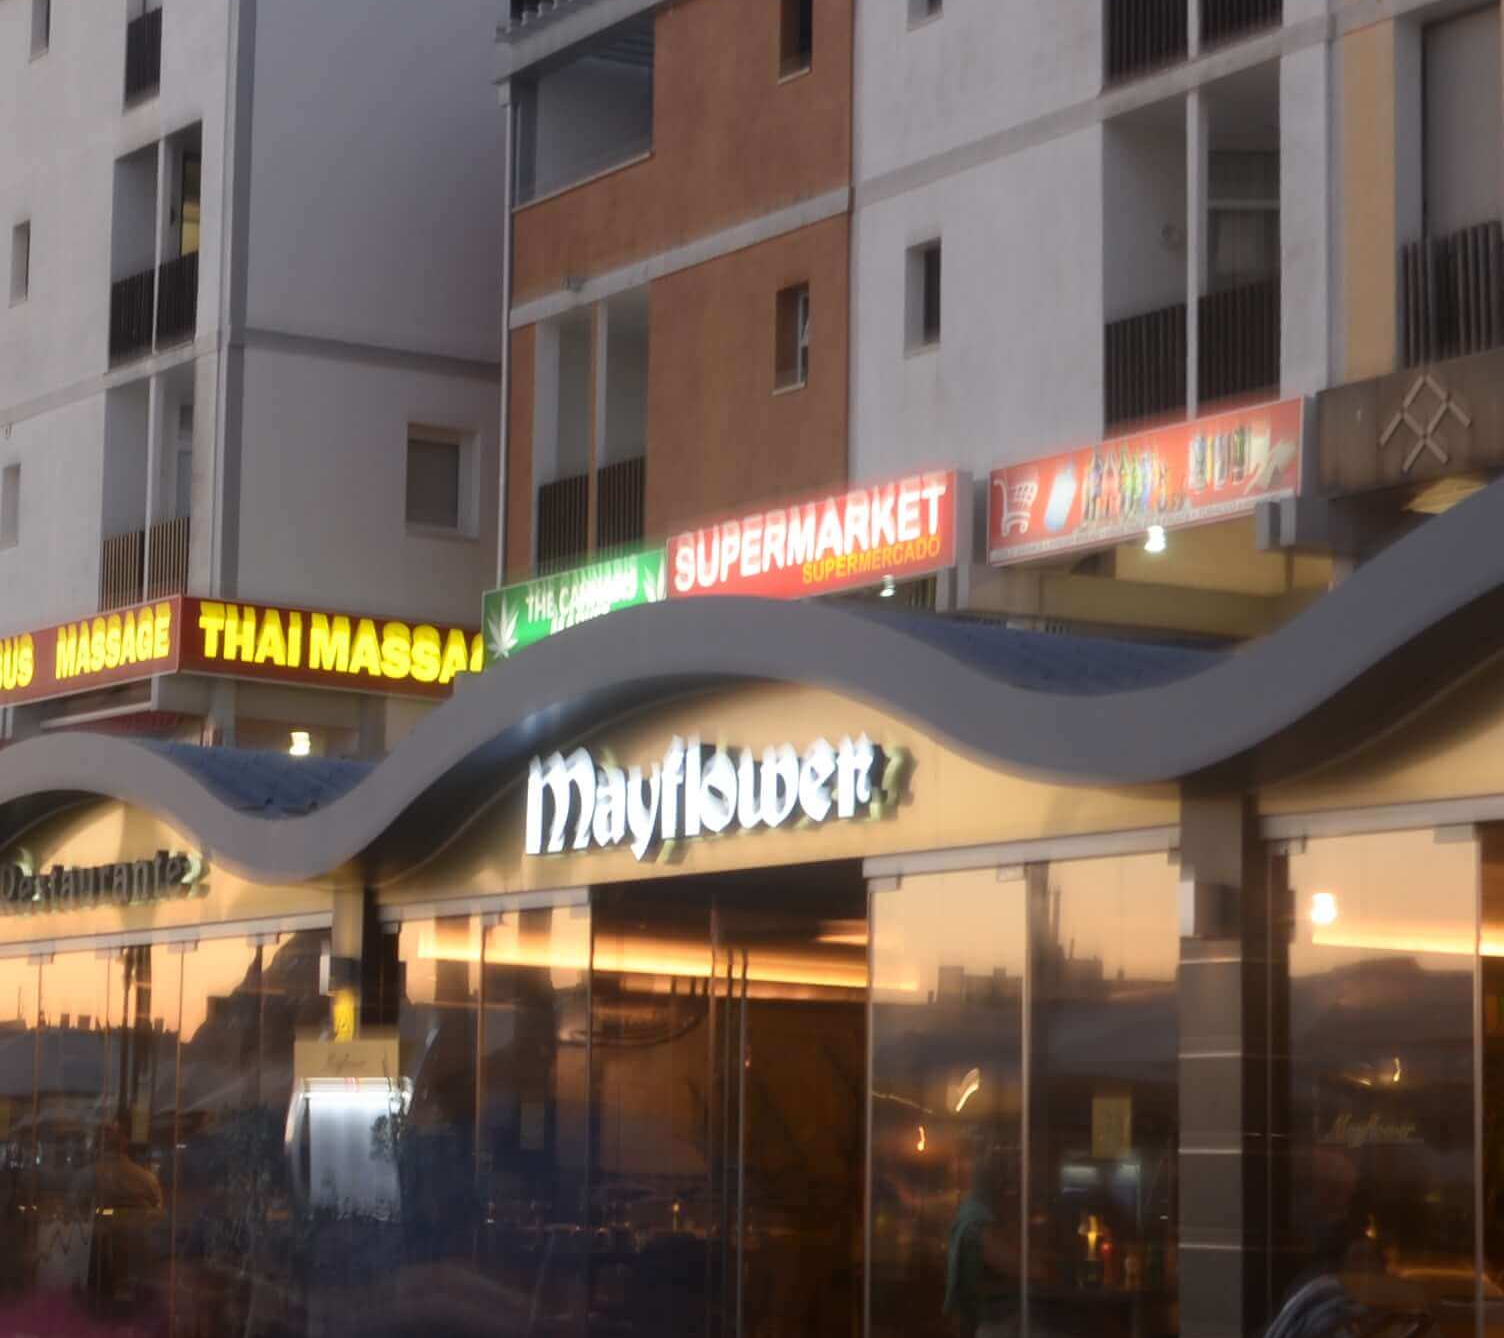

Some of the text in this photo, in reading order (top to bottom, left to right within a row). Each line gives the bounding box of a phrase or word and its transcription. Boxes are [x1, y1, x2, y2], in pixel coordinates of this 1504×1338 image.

[673, 481, 947, 592] SUPERMARKET
[802, 535, 942, 585] SUPERMERCADO
[55, 602, 171, 680] MASSAGE
[199, 601, 302, 667] THAI
[525, 731, 878, 861] Mayflower
